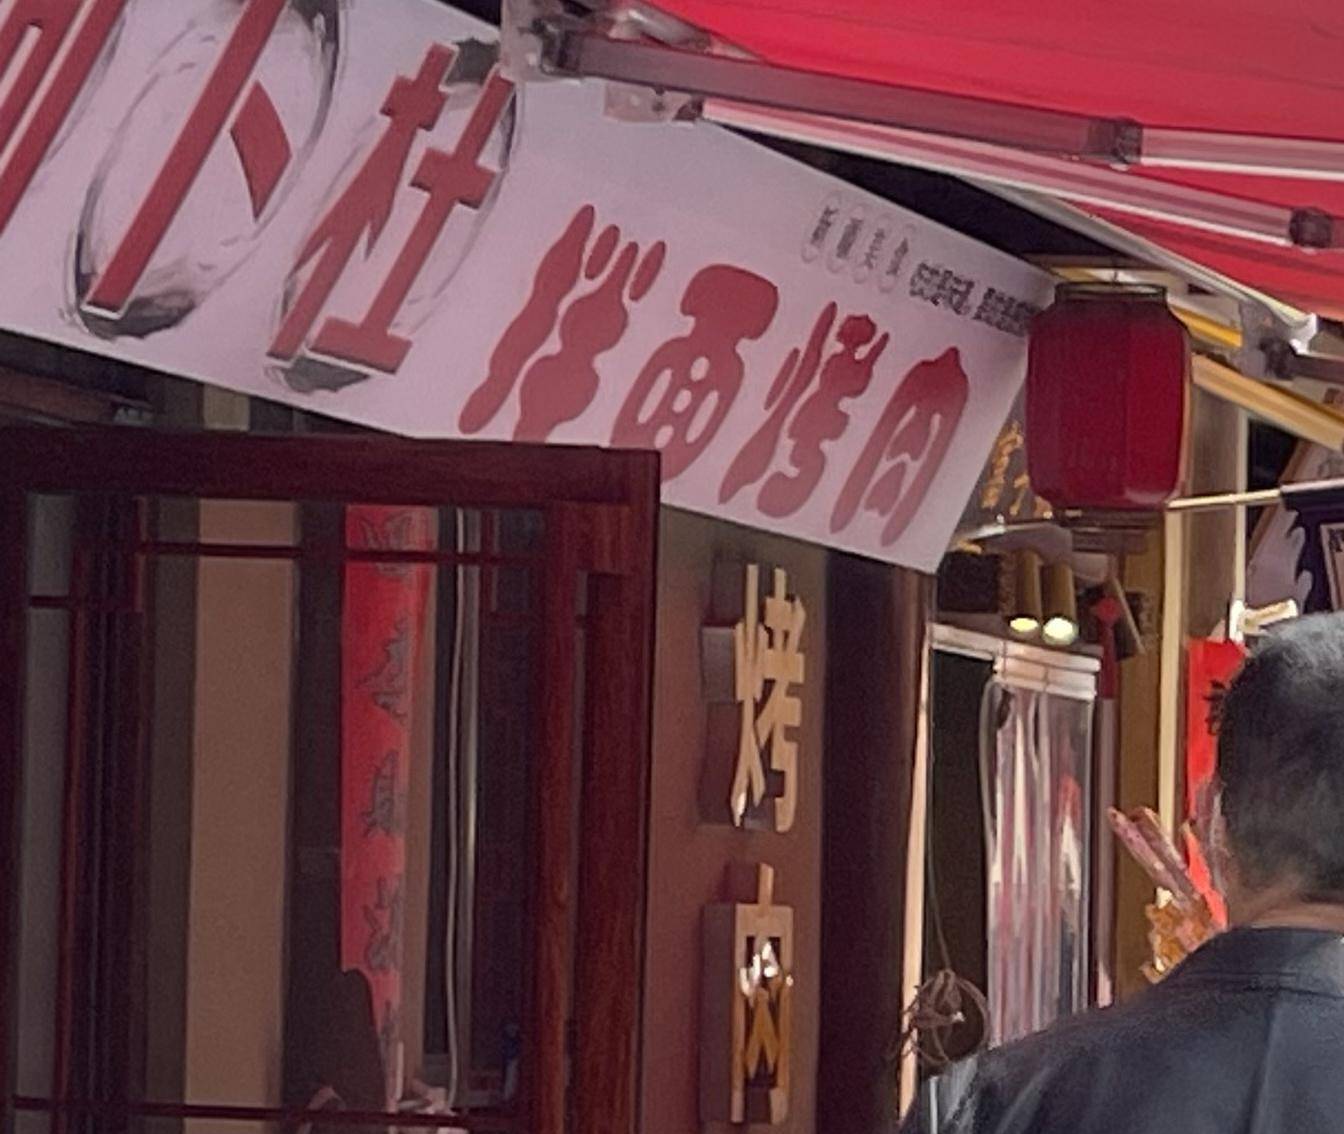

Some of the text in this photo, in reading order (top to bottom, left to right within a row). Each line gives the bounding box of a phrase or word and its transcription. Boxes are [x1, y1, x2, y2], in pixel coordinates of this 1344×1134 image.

[458, 204, 970, 548] 拌面烤肉
[731, 563, 806, 1124] 烤肉
